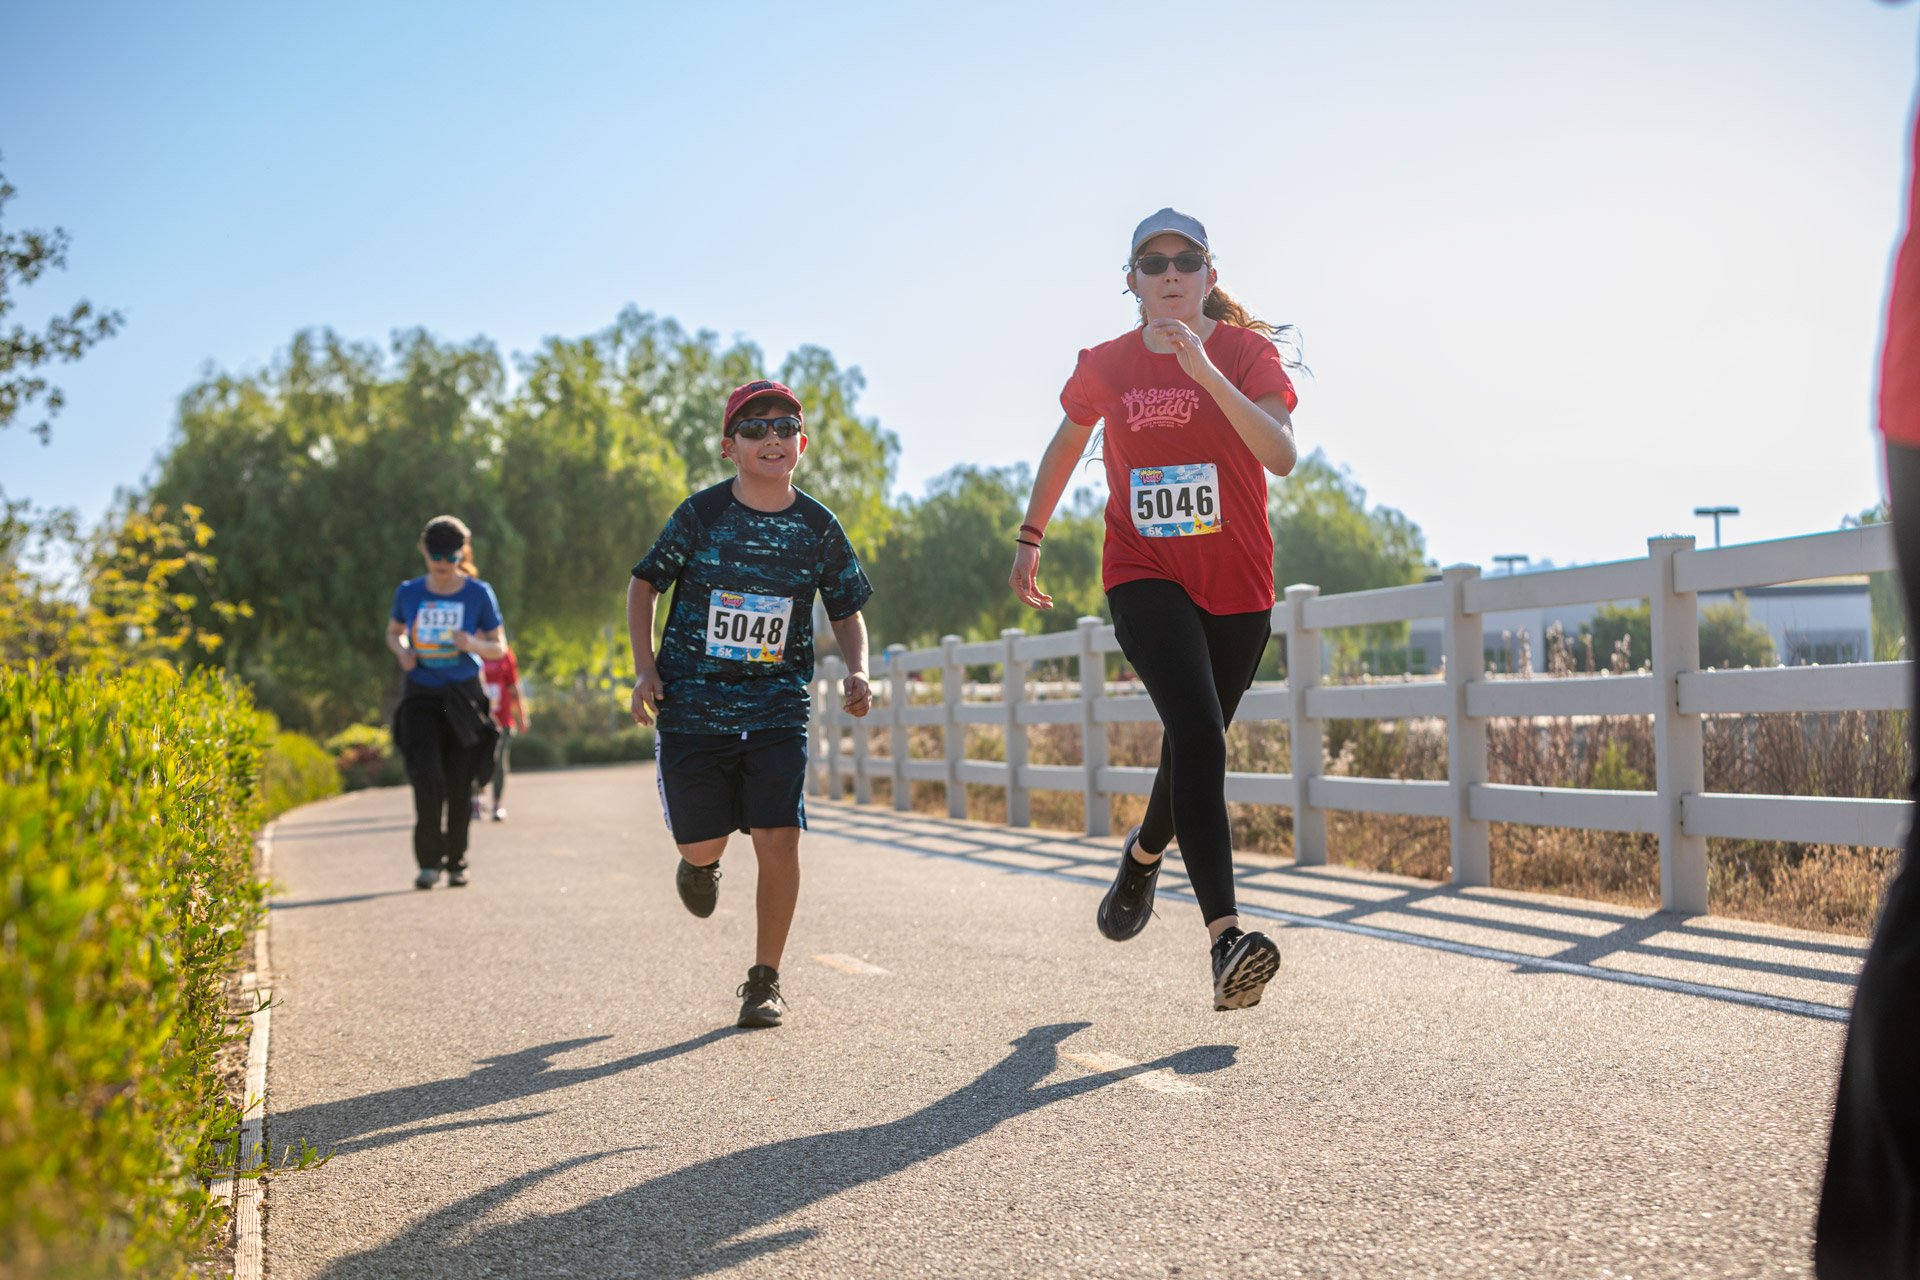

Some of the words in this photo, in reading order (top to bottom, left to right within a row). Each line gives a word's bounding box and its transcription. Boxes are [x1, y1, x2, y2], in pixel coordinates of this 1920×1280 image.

[1144, 387, 1195, 404] Sugar
[1126, 398, 1193, 430] Daddy
[1137, 485, 1214, 520] 5046
[713, 610, 784, 645] 5048
